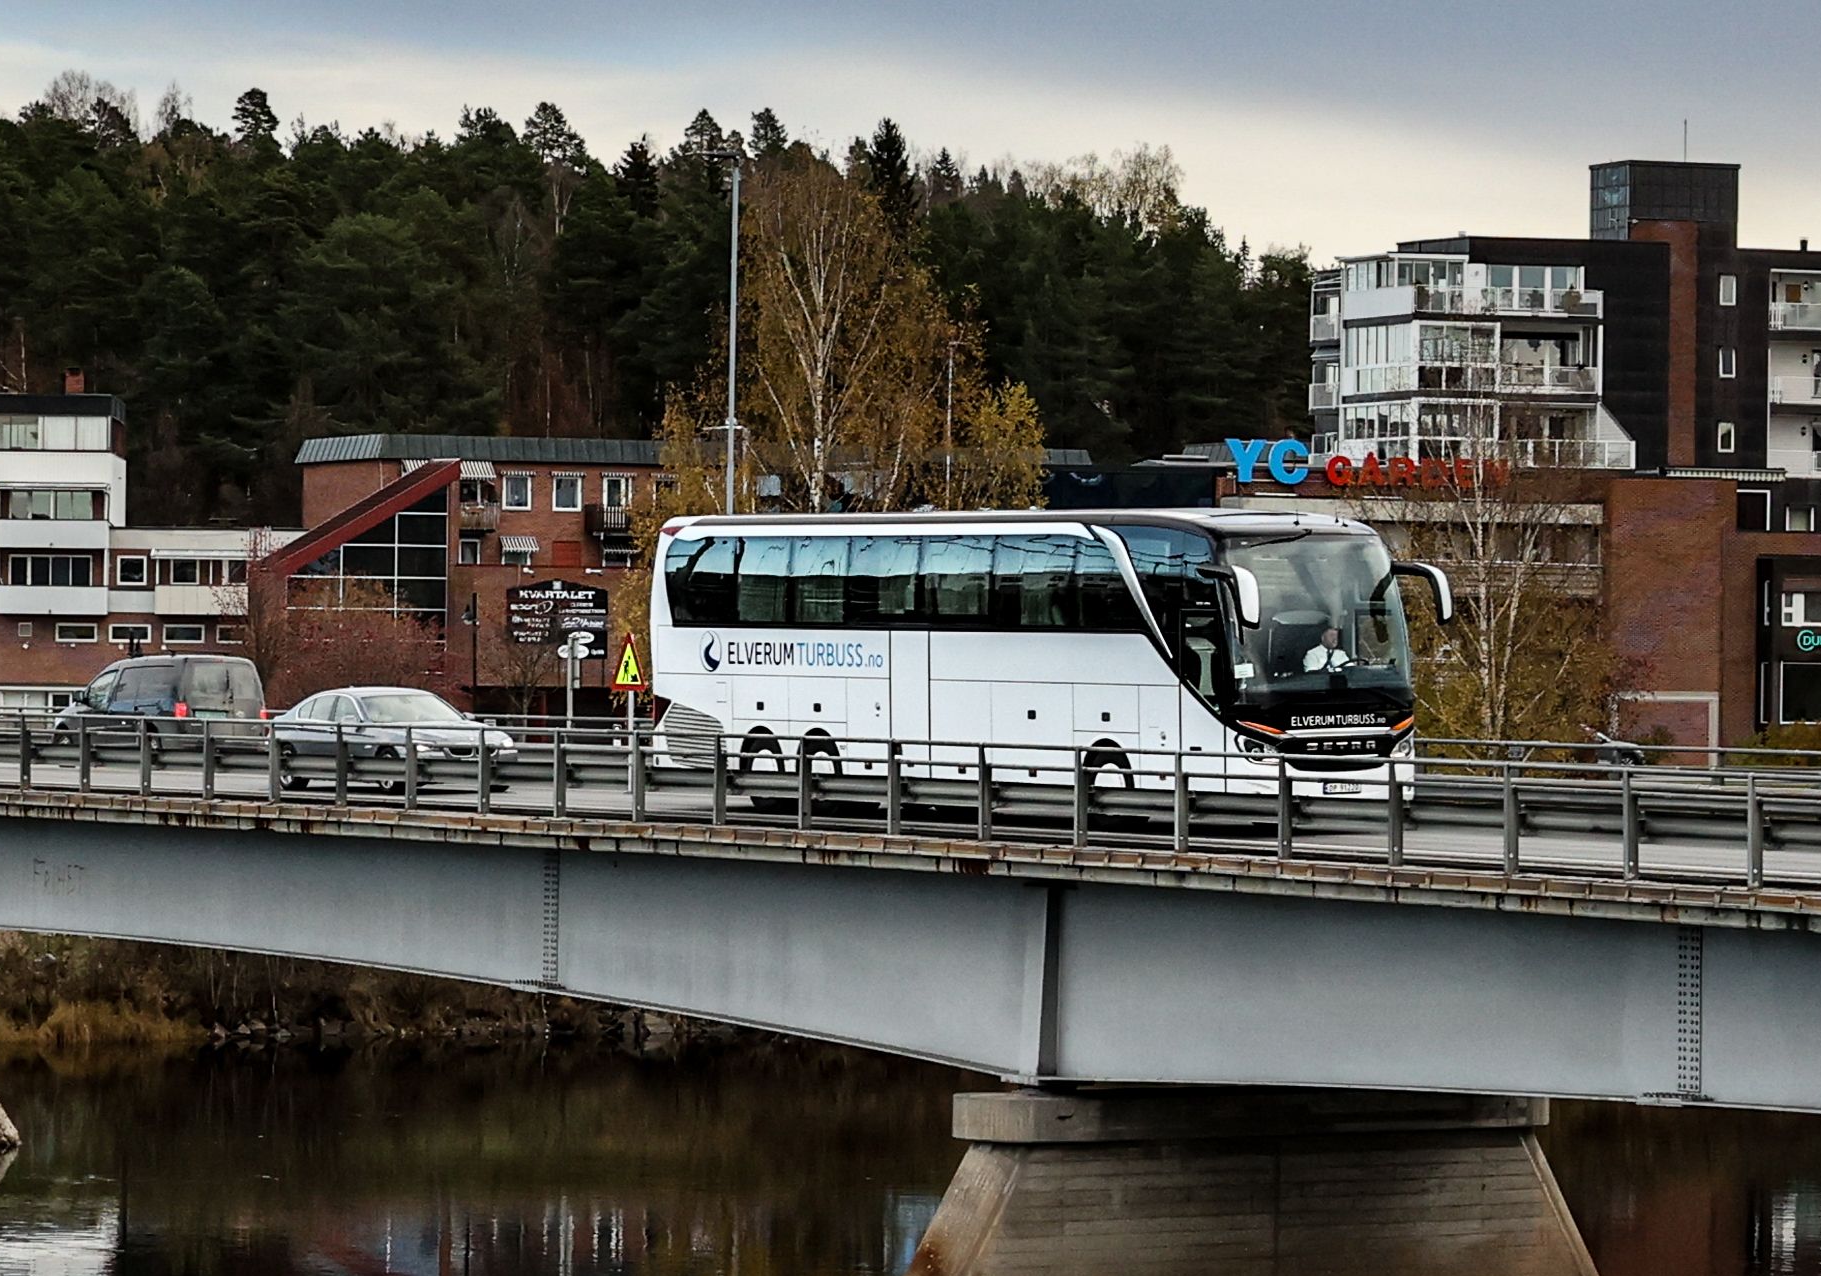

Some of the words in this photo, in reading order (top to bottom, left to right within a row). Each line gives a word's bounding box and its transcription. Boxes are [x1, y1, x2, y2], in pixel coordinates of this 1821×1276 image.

[1225, 438, 1309, 485] YC
[519, 590, 596, 600] KVARTALET
[1306, 740, 1376, 751] SETRA
